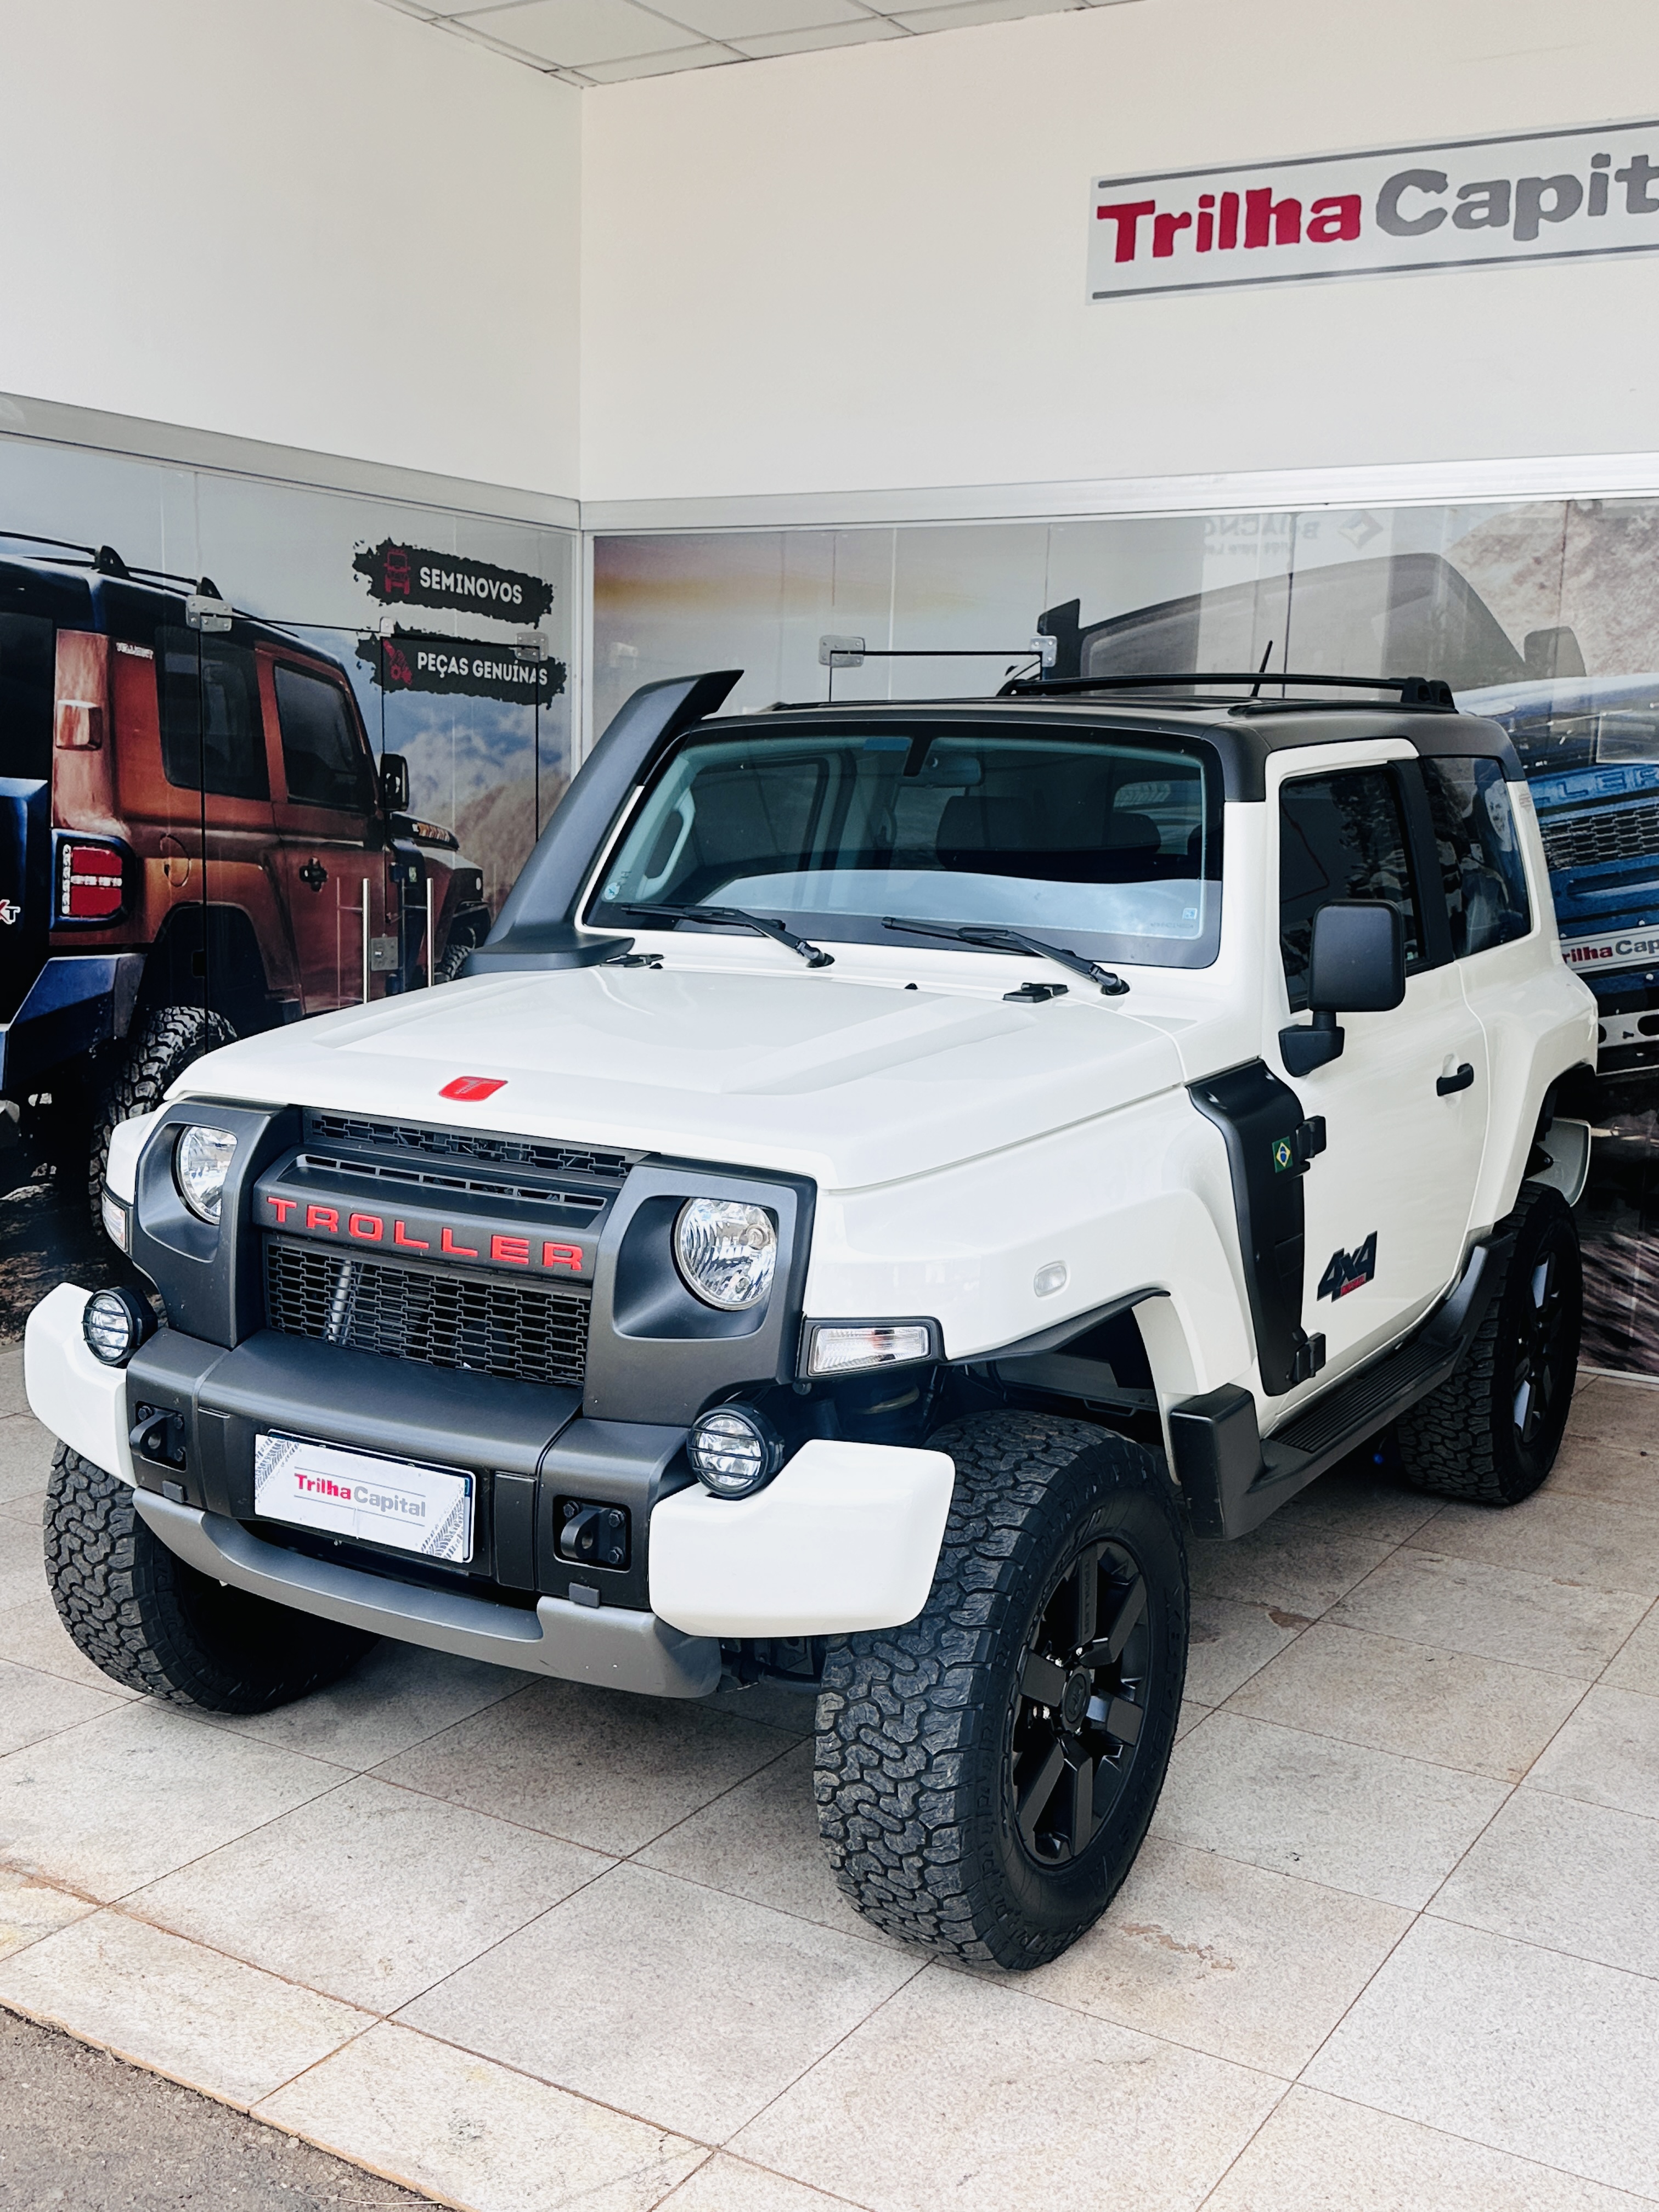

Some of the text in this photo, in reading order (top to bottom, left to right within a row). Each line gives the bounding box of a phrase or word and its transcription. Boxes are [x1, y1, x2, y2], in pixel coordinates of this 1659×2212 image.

[419, 566, 523, 605] SEMINOVOS
[417, 652, 548, 685] PEÇAS GENUÍNAS
[267, 1196, 583, 1272] TROLLER
